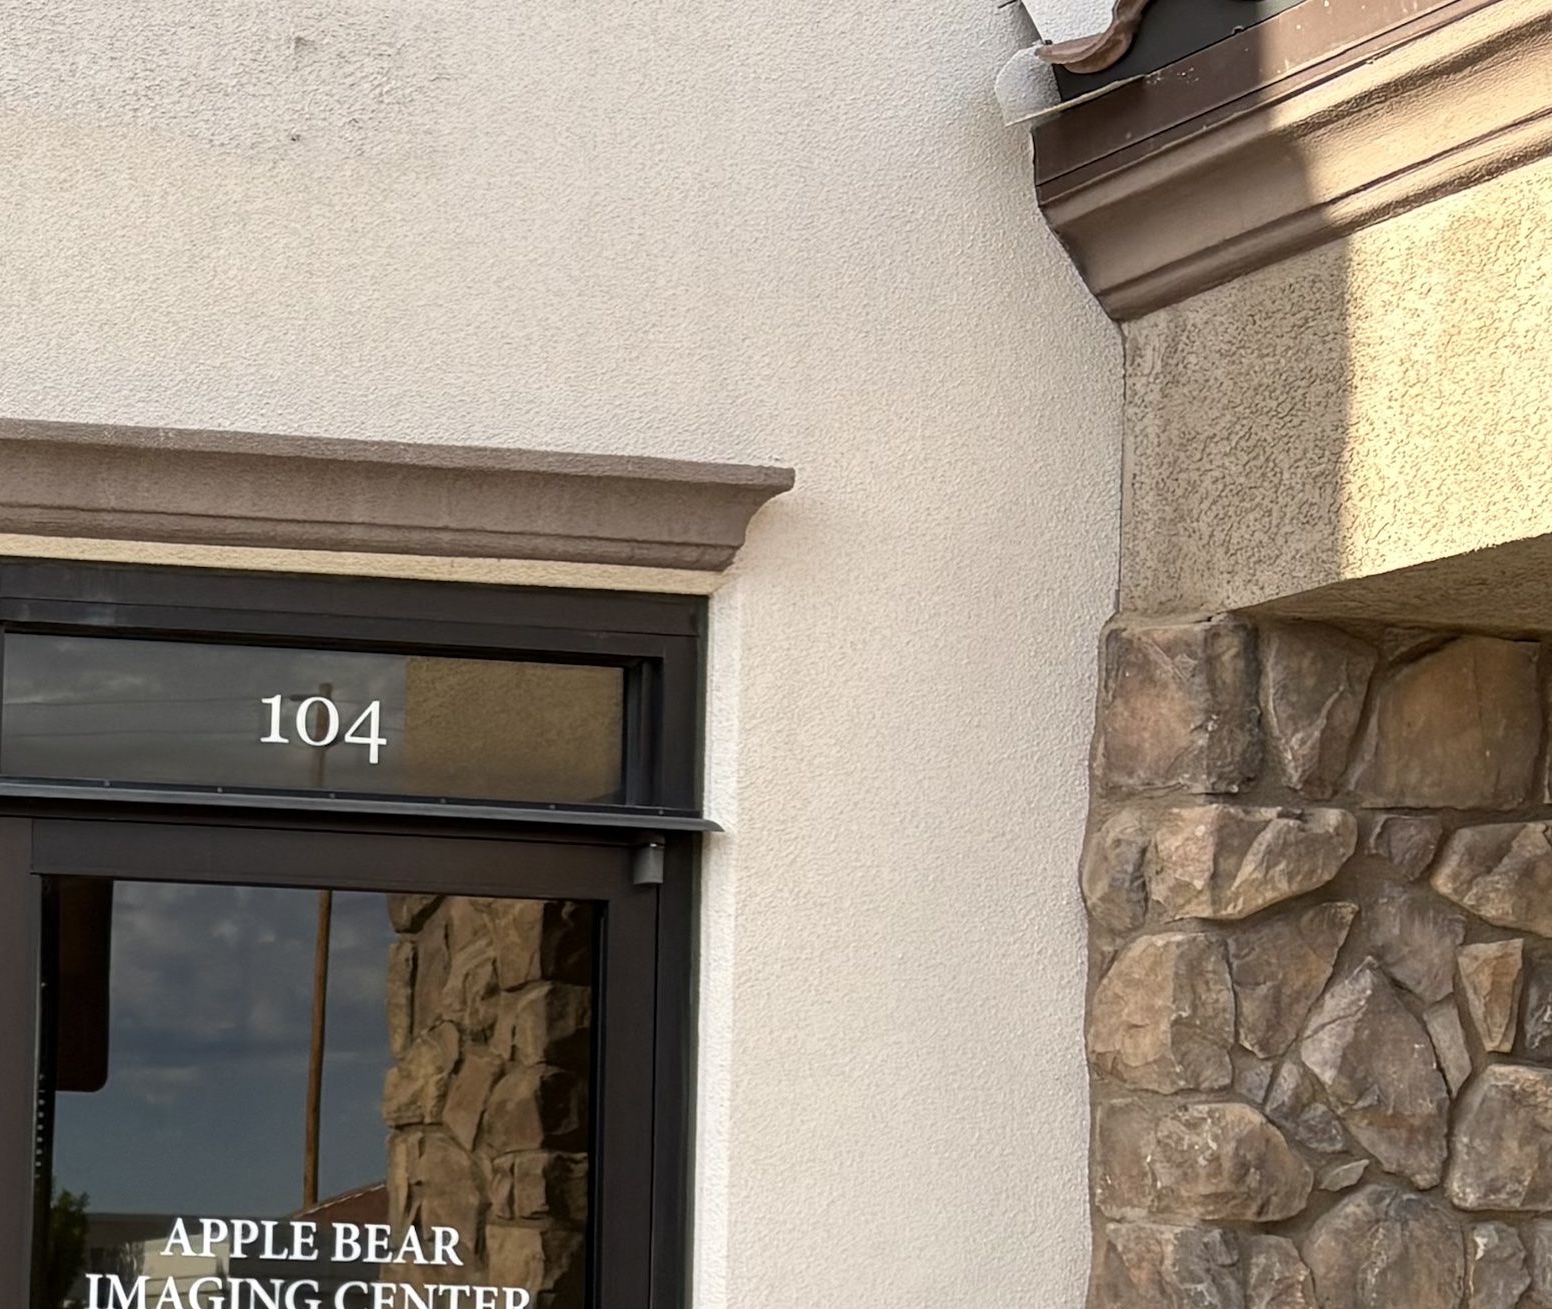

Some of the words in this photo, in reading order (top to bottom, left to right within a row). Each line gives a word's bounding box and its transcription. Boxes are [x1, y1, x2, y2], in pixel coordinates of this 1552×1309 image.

[260, 694, 387, 764] 104
[159, 1217, 319, 1260] APPLE
[331, 1222, 464, 1266] BEAR
